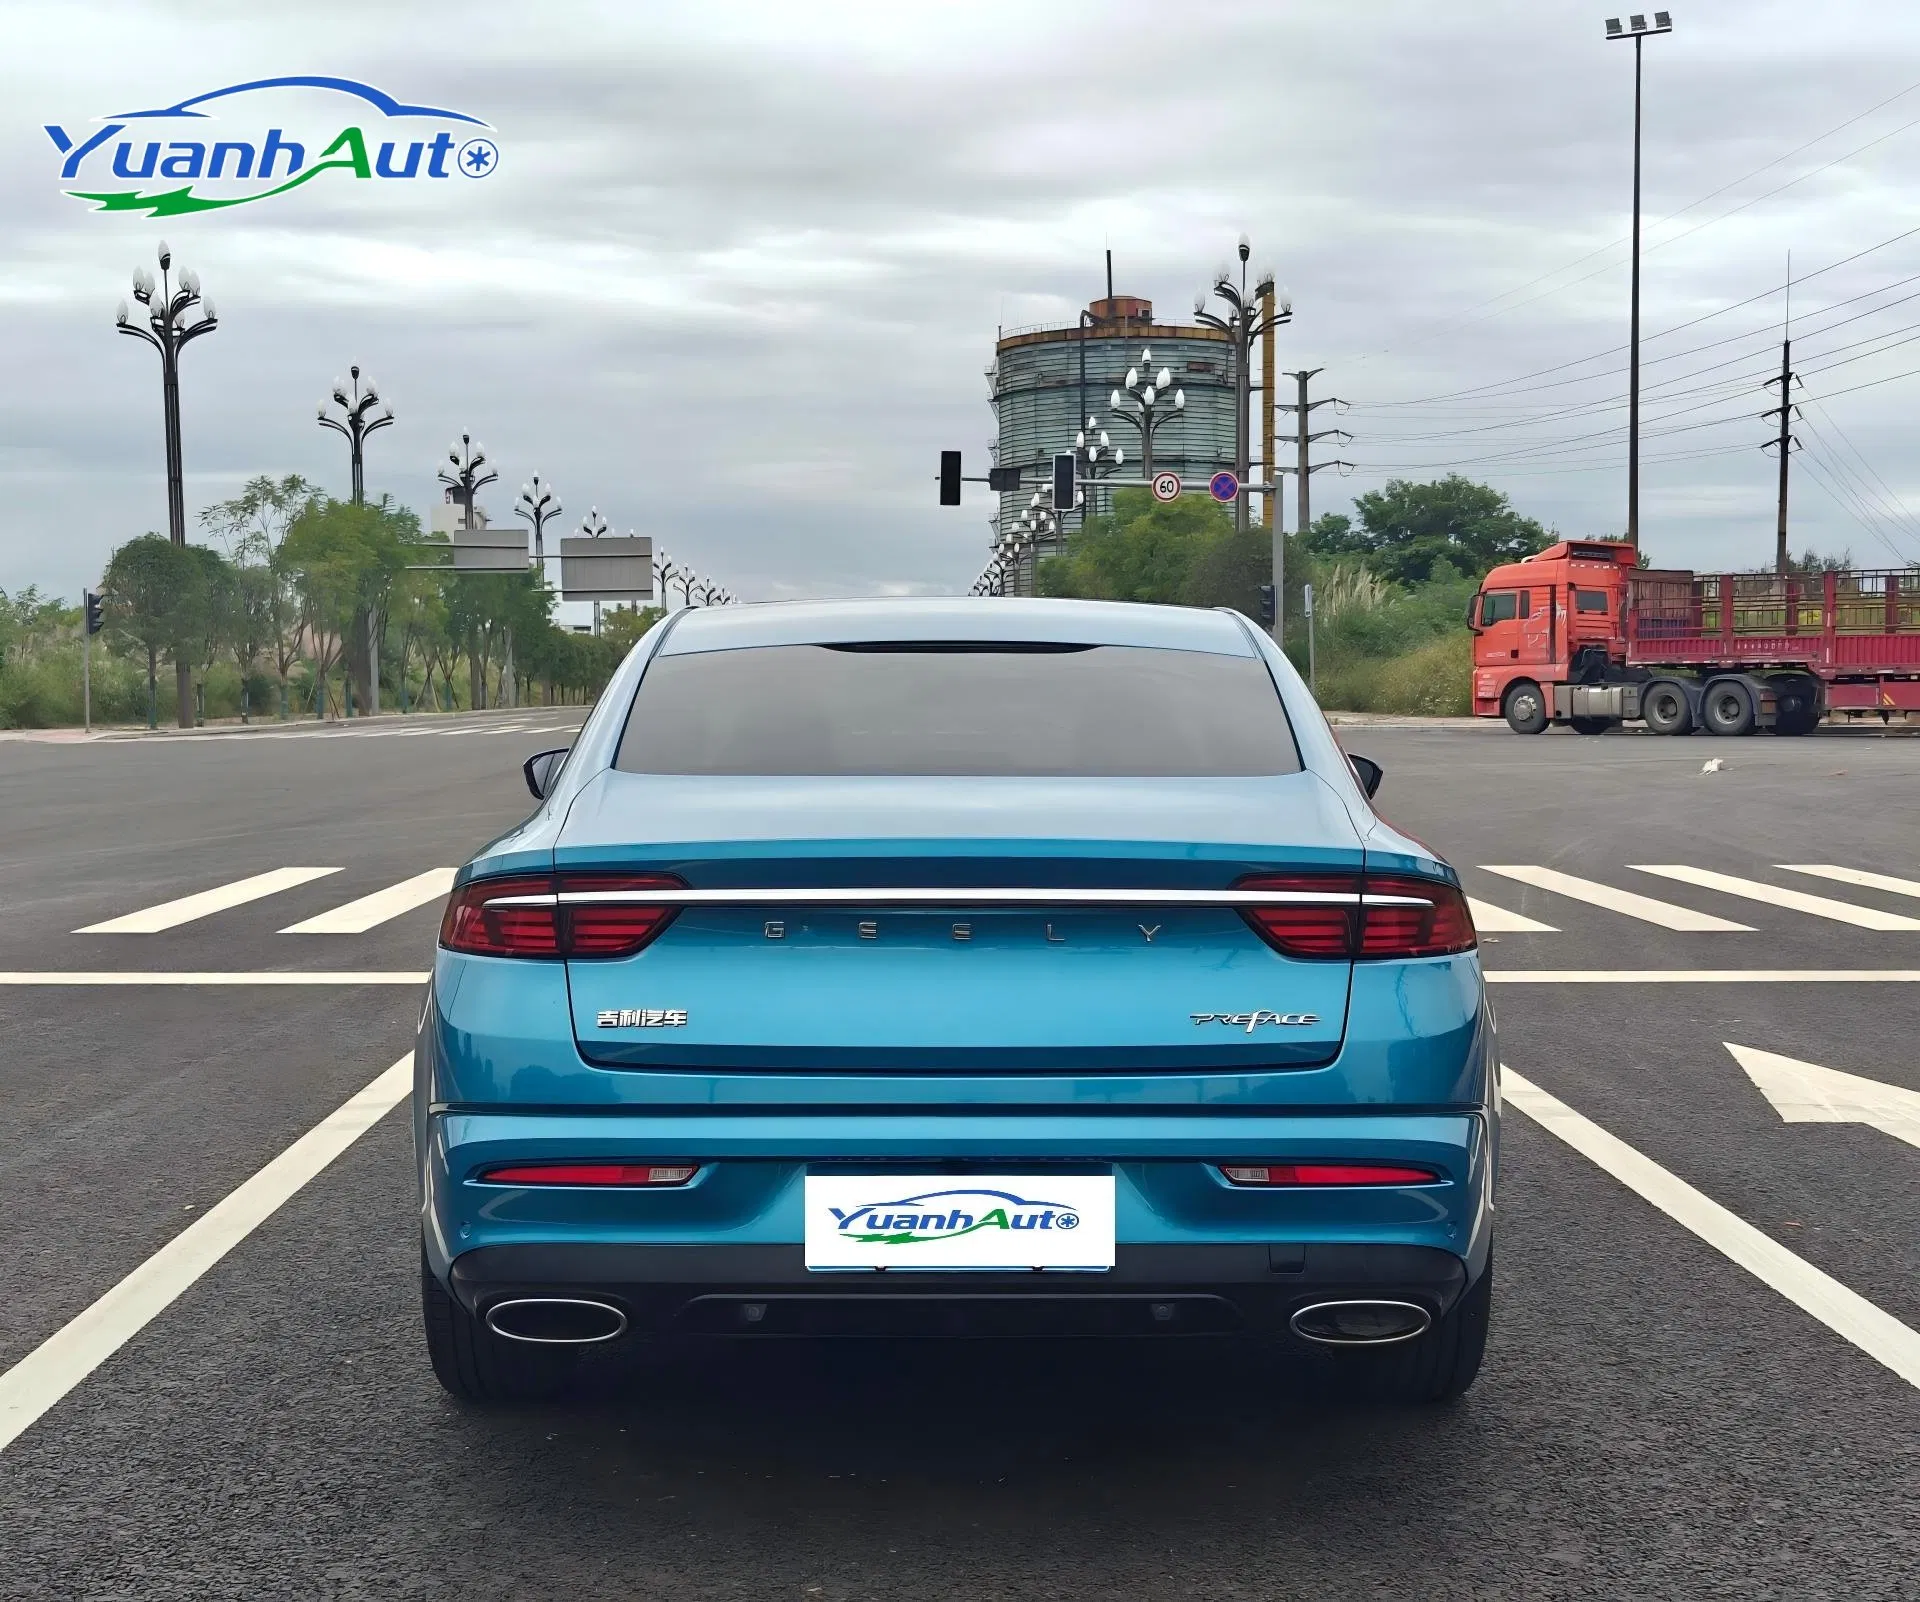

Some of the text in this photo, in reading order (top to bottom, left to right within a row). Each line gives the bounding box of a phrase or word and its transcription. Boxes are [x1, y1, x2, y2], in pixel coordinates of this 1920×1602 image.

[1160, 480, 1174, 493] 60
[764, 921, 1161, 943] GEELY
[597, 1008, 687, 1028] 吉利汽车
